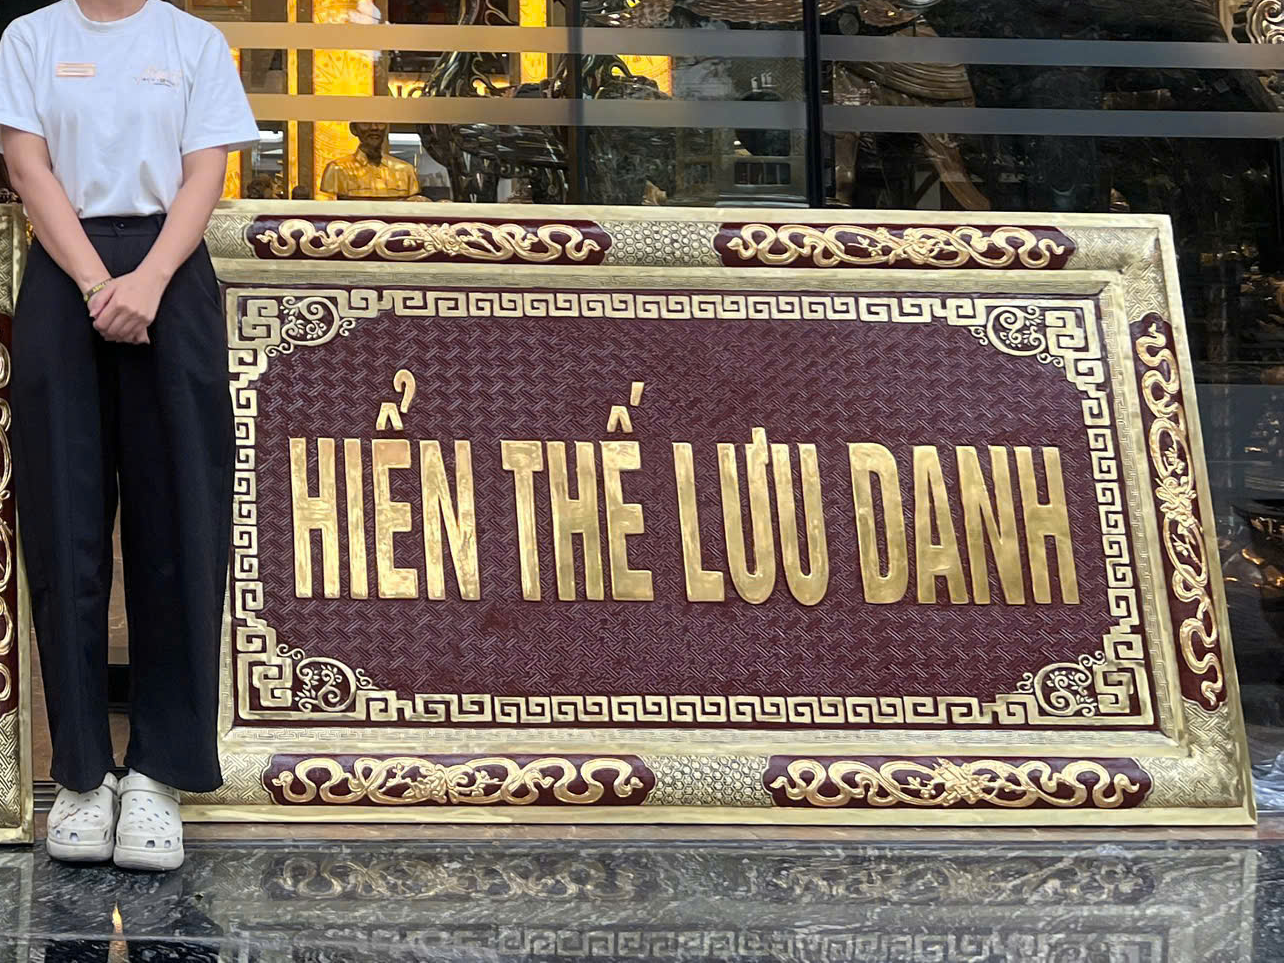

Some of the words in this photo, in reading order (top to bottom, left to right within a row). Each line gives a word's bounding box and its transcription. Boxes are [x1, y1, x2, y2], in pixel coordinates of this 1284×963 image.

[289, 369, 481, 601] HIỂN
[501, 381, 654, 602] THẾ
[671, 426, 830, 606] LƯU
[848, 442, 1080, 605] DANH
